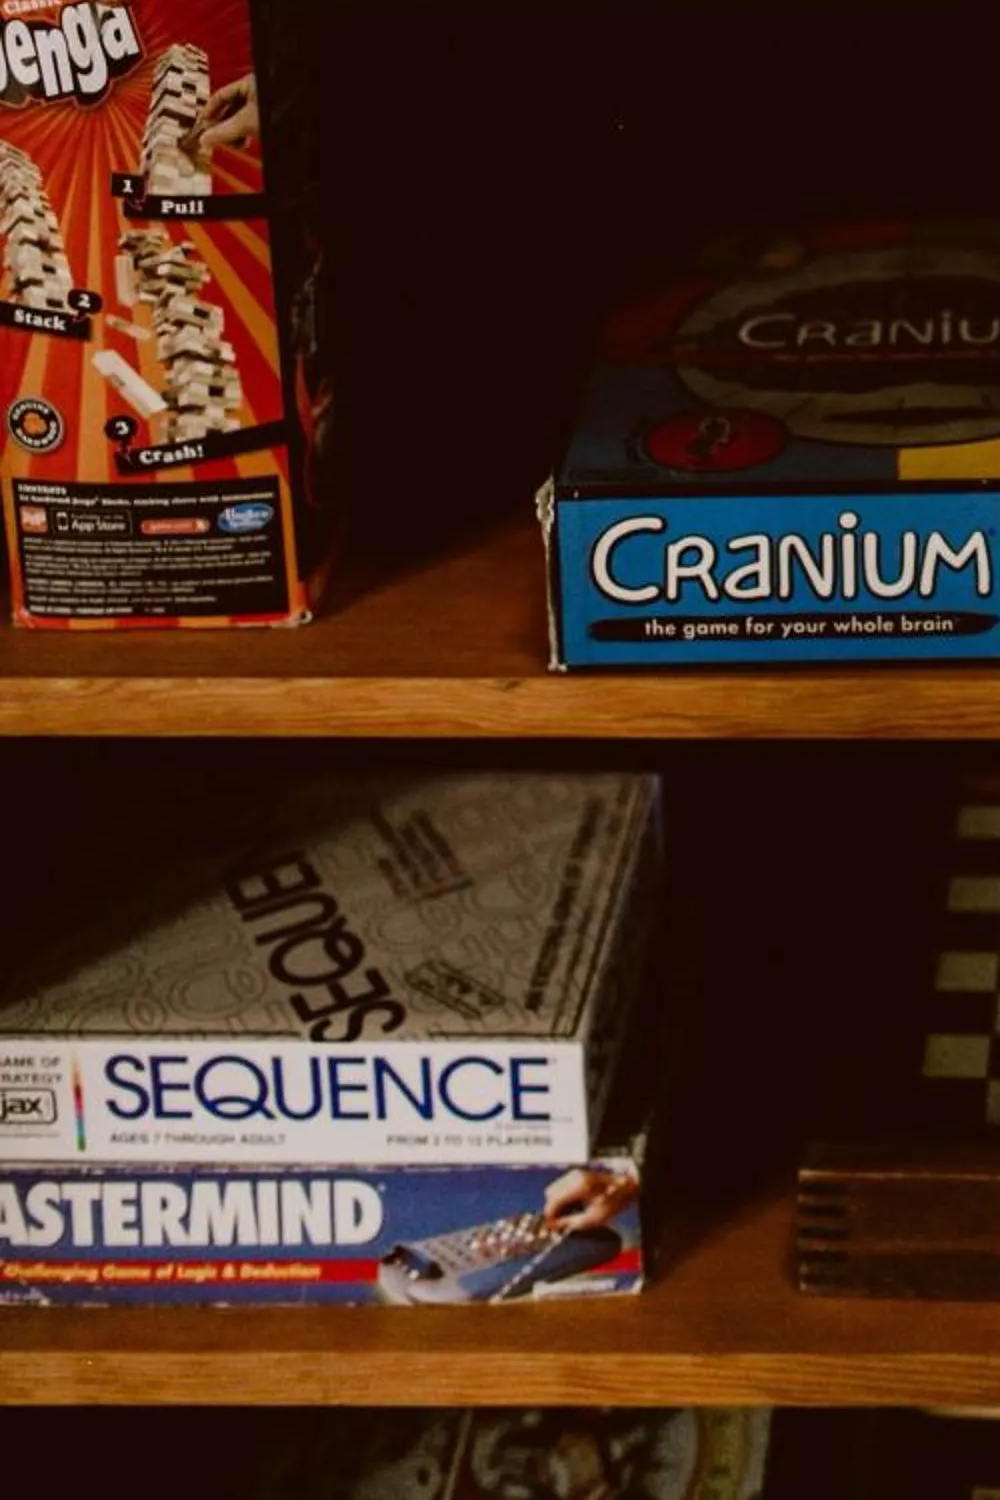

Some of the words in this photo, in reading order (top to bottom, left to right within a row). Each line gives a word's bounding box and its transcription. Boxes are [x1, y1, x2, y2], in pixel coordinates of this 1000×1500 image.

[121, 179, 134, 194] 1
[160, 199, 206, 216] Pull
[77, 293, 92, 309] 2
[13, 308, 68, 332] Stack
[138, 443, 205, 466] Crash!
[644, 617, 677, 637] the
[682, 621, 740, 640] game
[745, 615, 775, 635] for
[781, 619, 827, 639] your
[833, 615, 894, 634] whole
[900, 613, 954, 633] brain
[0, 1055, 35, 1068] AME
[105, 1054, 551, 1121] SEQUENCE
[101, 1263, 151, 1280] Game
[156, 1262, 175, 1280] of
